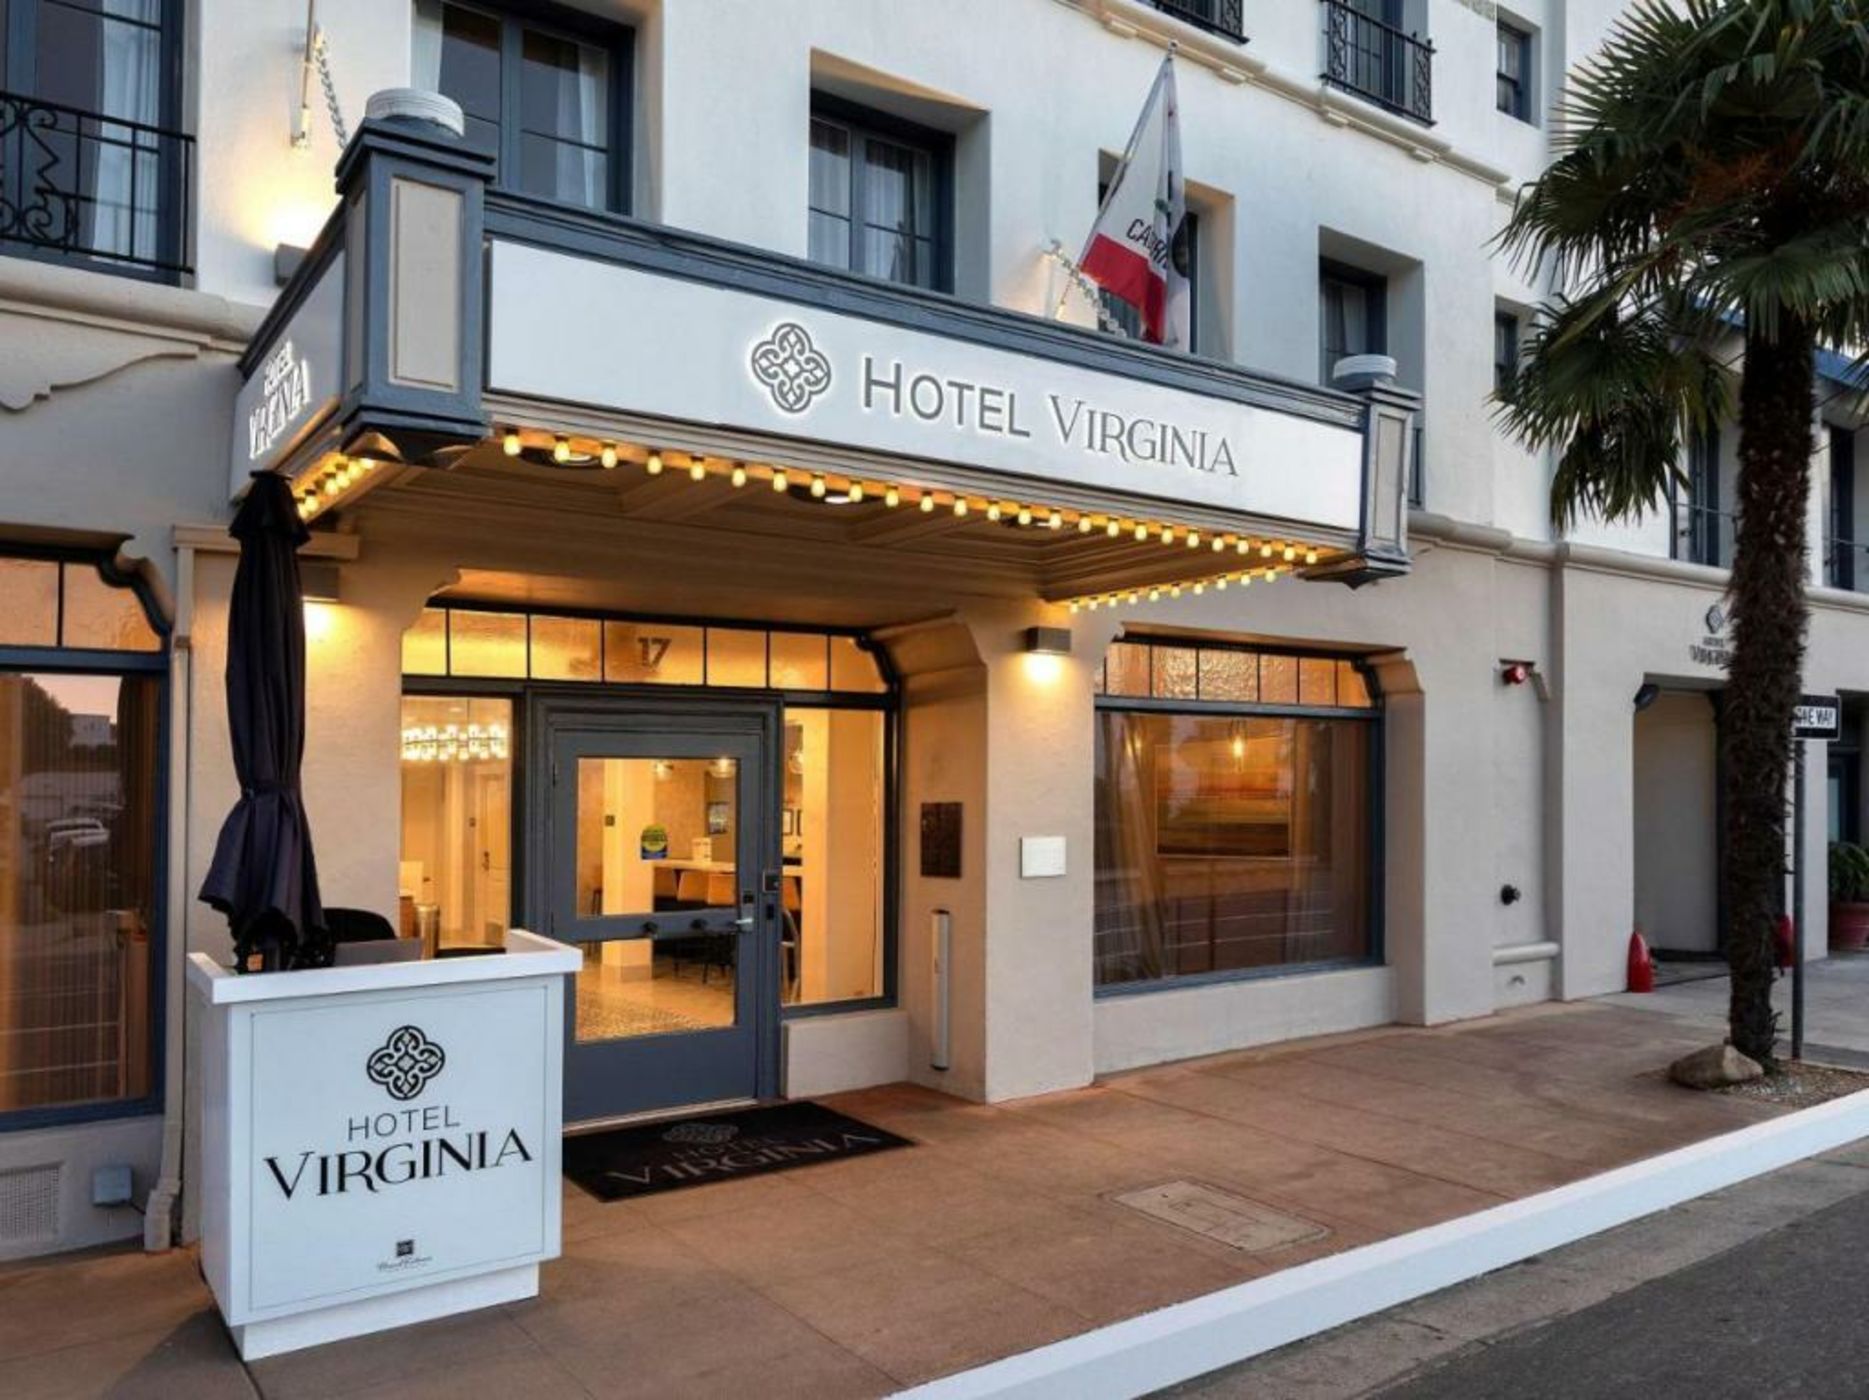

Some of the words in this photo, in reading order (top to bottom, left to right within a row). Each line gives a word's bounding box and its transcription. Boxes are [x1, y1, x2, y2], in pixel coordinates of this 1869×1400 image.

[863, 356, 1031, 439] HOTEL
[1050, 394, 1239, 478] VIRGINIA
[637, 636, 672, 671] 17
[347, 1105, 461, 1141] HOTEL
[263, 1128, 533, 1200] VIRGINIA
